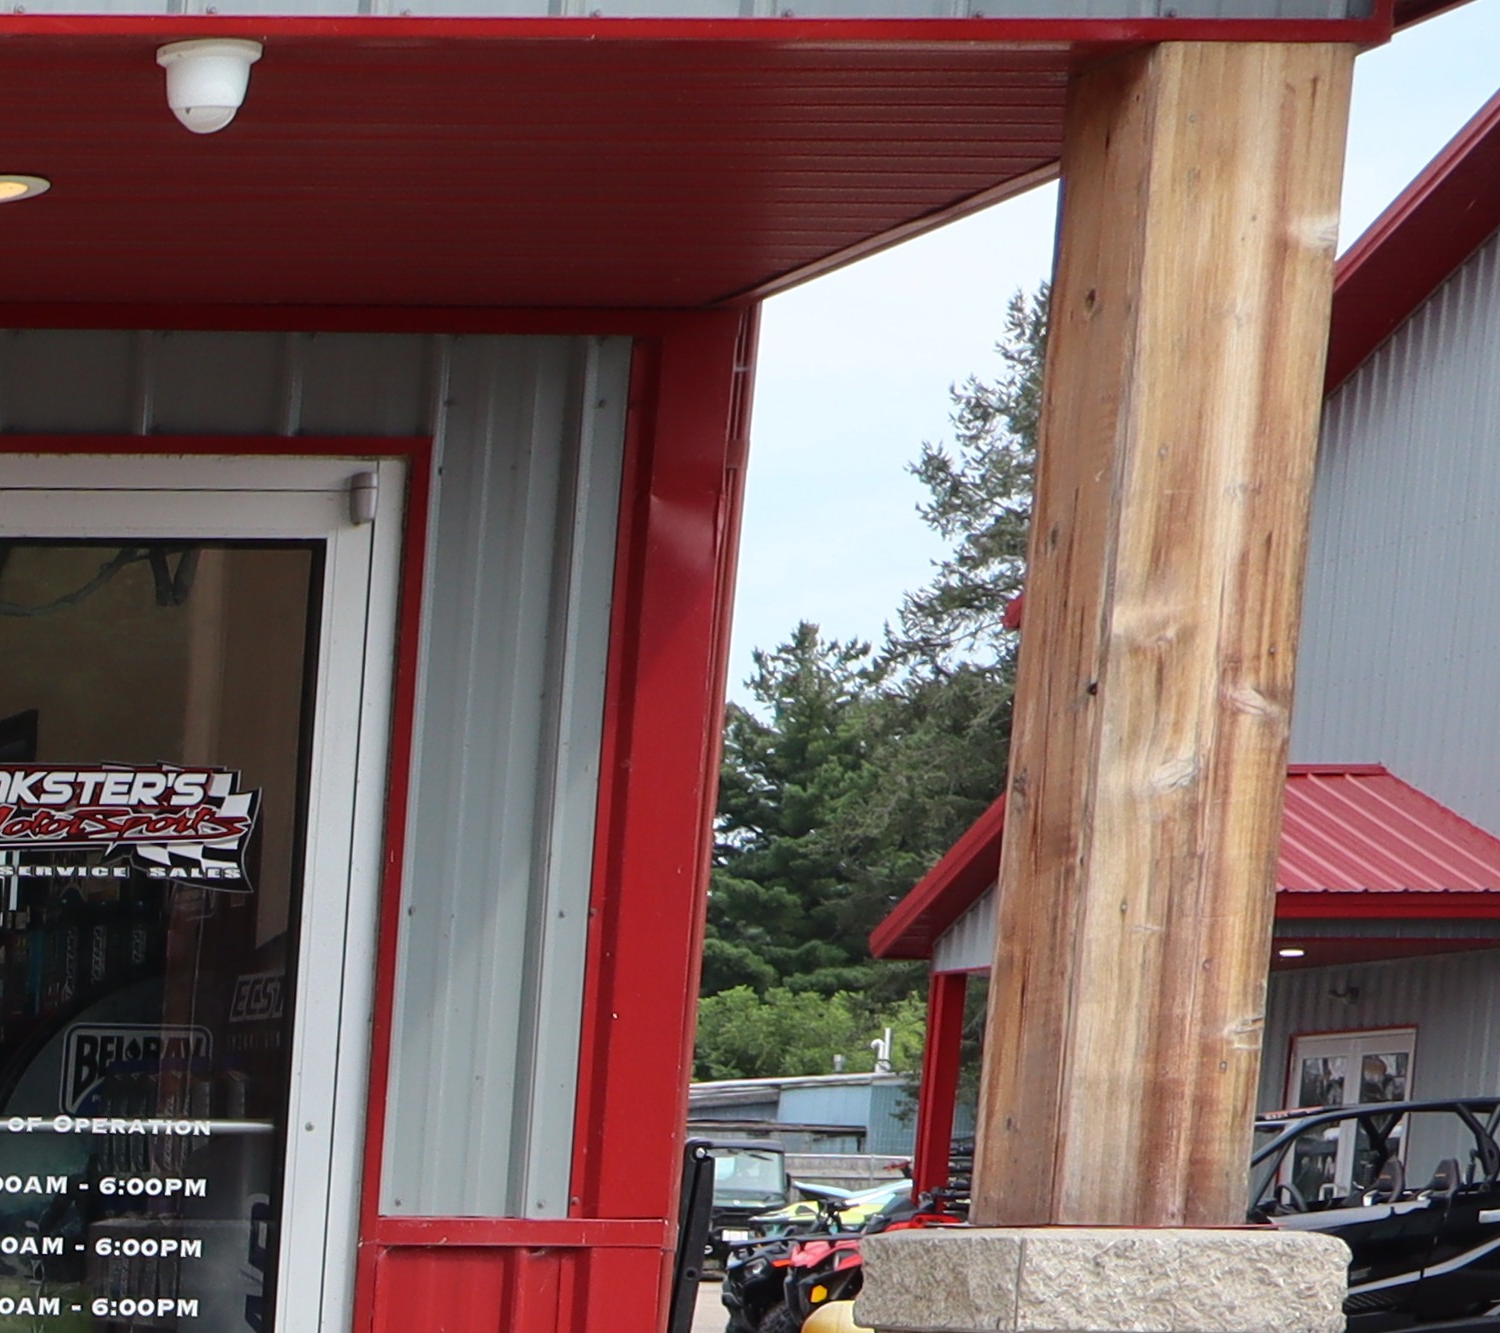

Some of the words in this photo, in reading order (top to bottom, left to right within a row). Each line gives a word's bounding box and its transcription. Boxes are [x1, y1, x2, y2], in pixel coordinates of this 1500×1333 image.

[149, 865, 243, 880] SALES
[99, 1177, 206, 1197] 6:00PM
[95, 1238, 202, 1258] 6:00PM
[92, 1298, 199, 1317] 6:00PM
